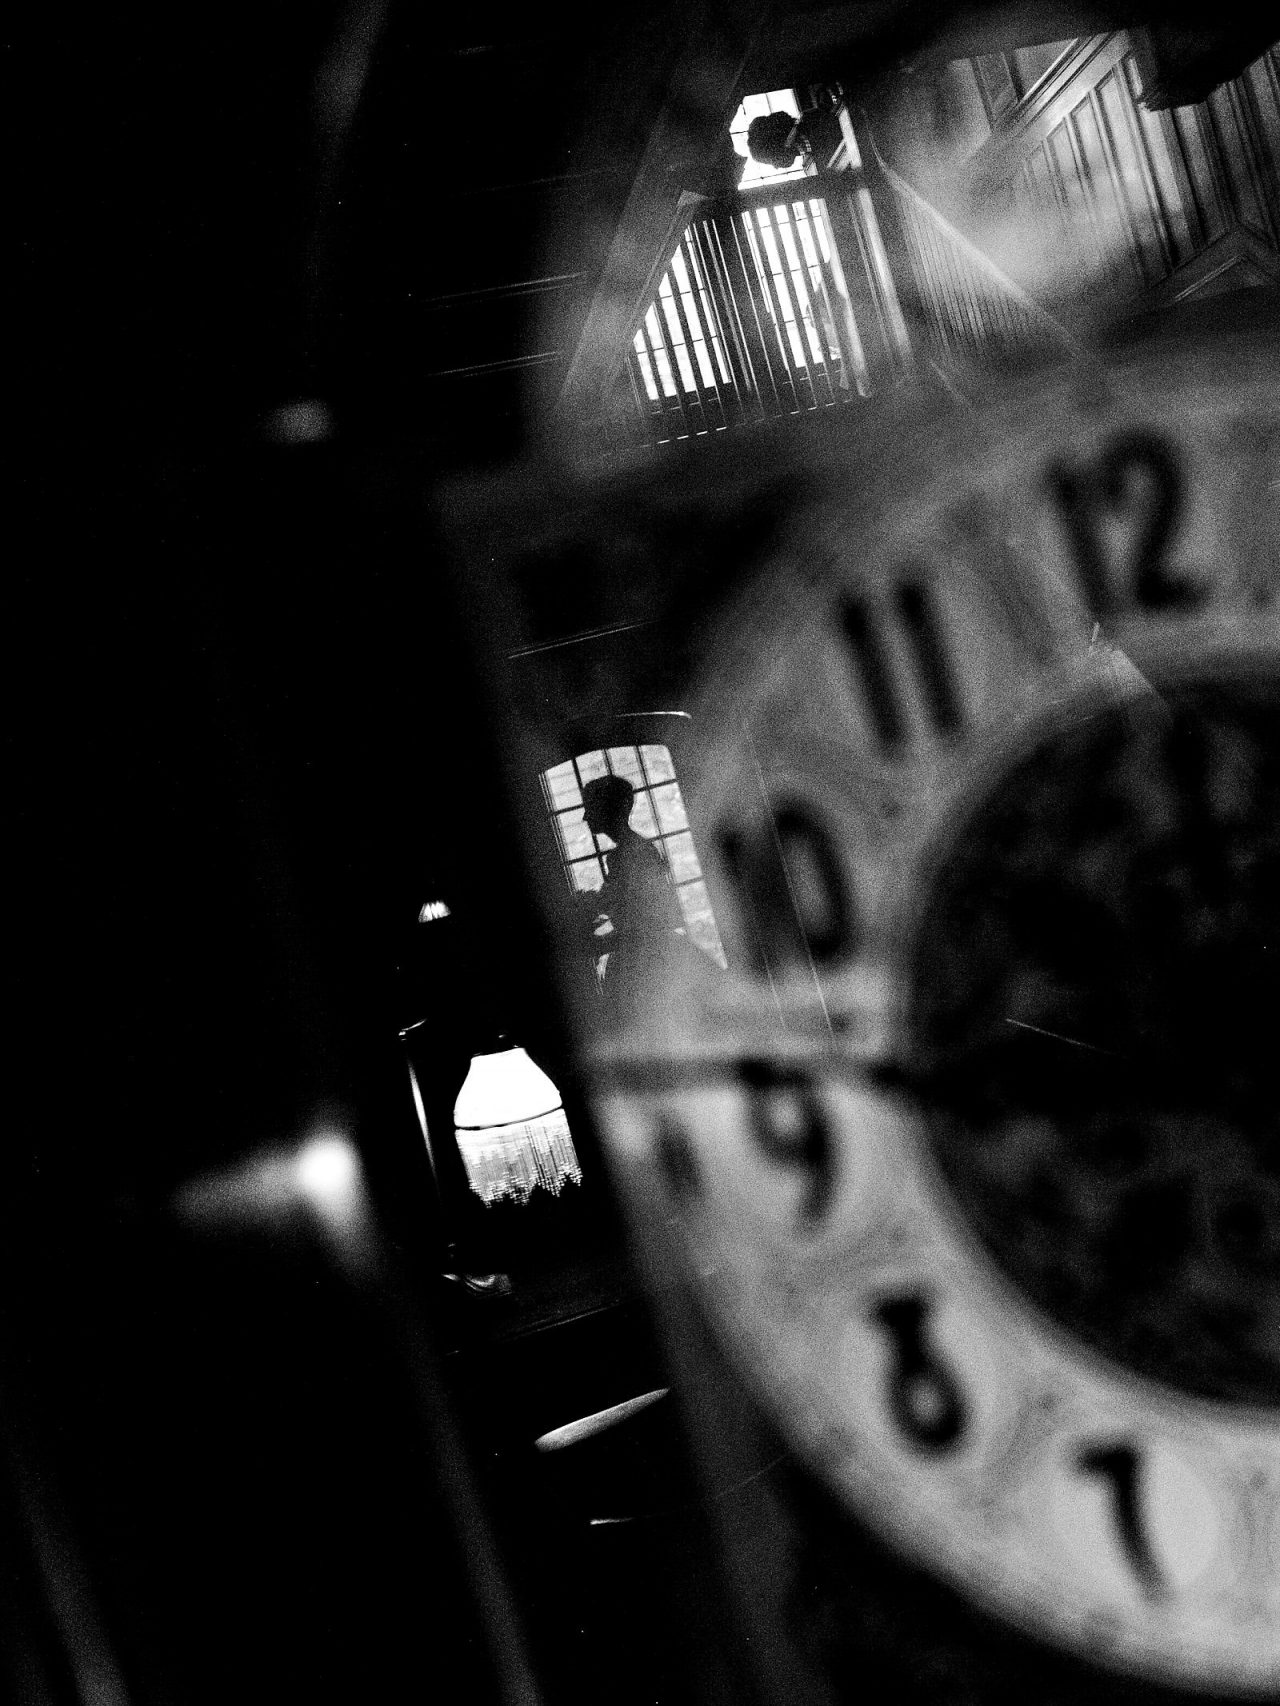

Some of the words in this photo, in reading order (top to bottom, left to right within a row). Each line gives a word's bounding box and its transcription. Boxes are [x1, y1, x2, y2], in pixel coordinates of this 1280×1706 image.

[1046, 427, 1206, 620] 12
[837, 572, 965, 762] 11
[712, 797, 858, 975] 10
[737, 1056, 840, 1237] 9
[872, 1288, 970, 1460] 8
[1070, 1434, 1172, 1602] 7
